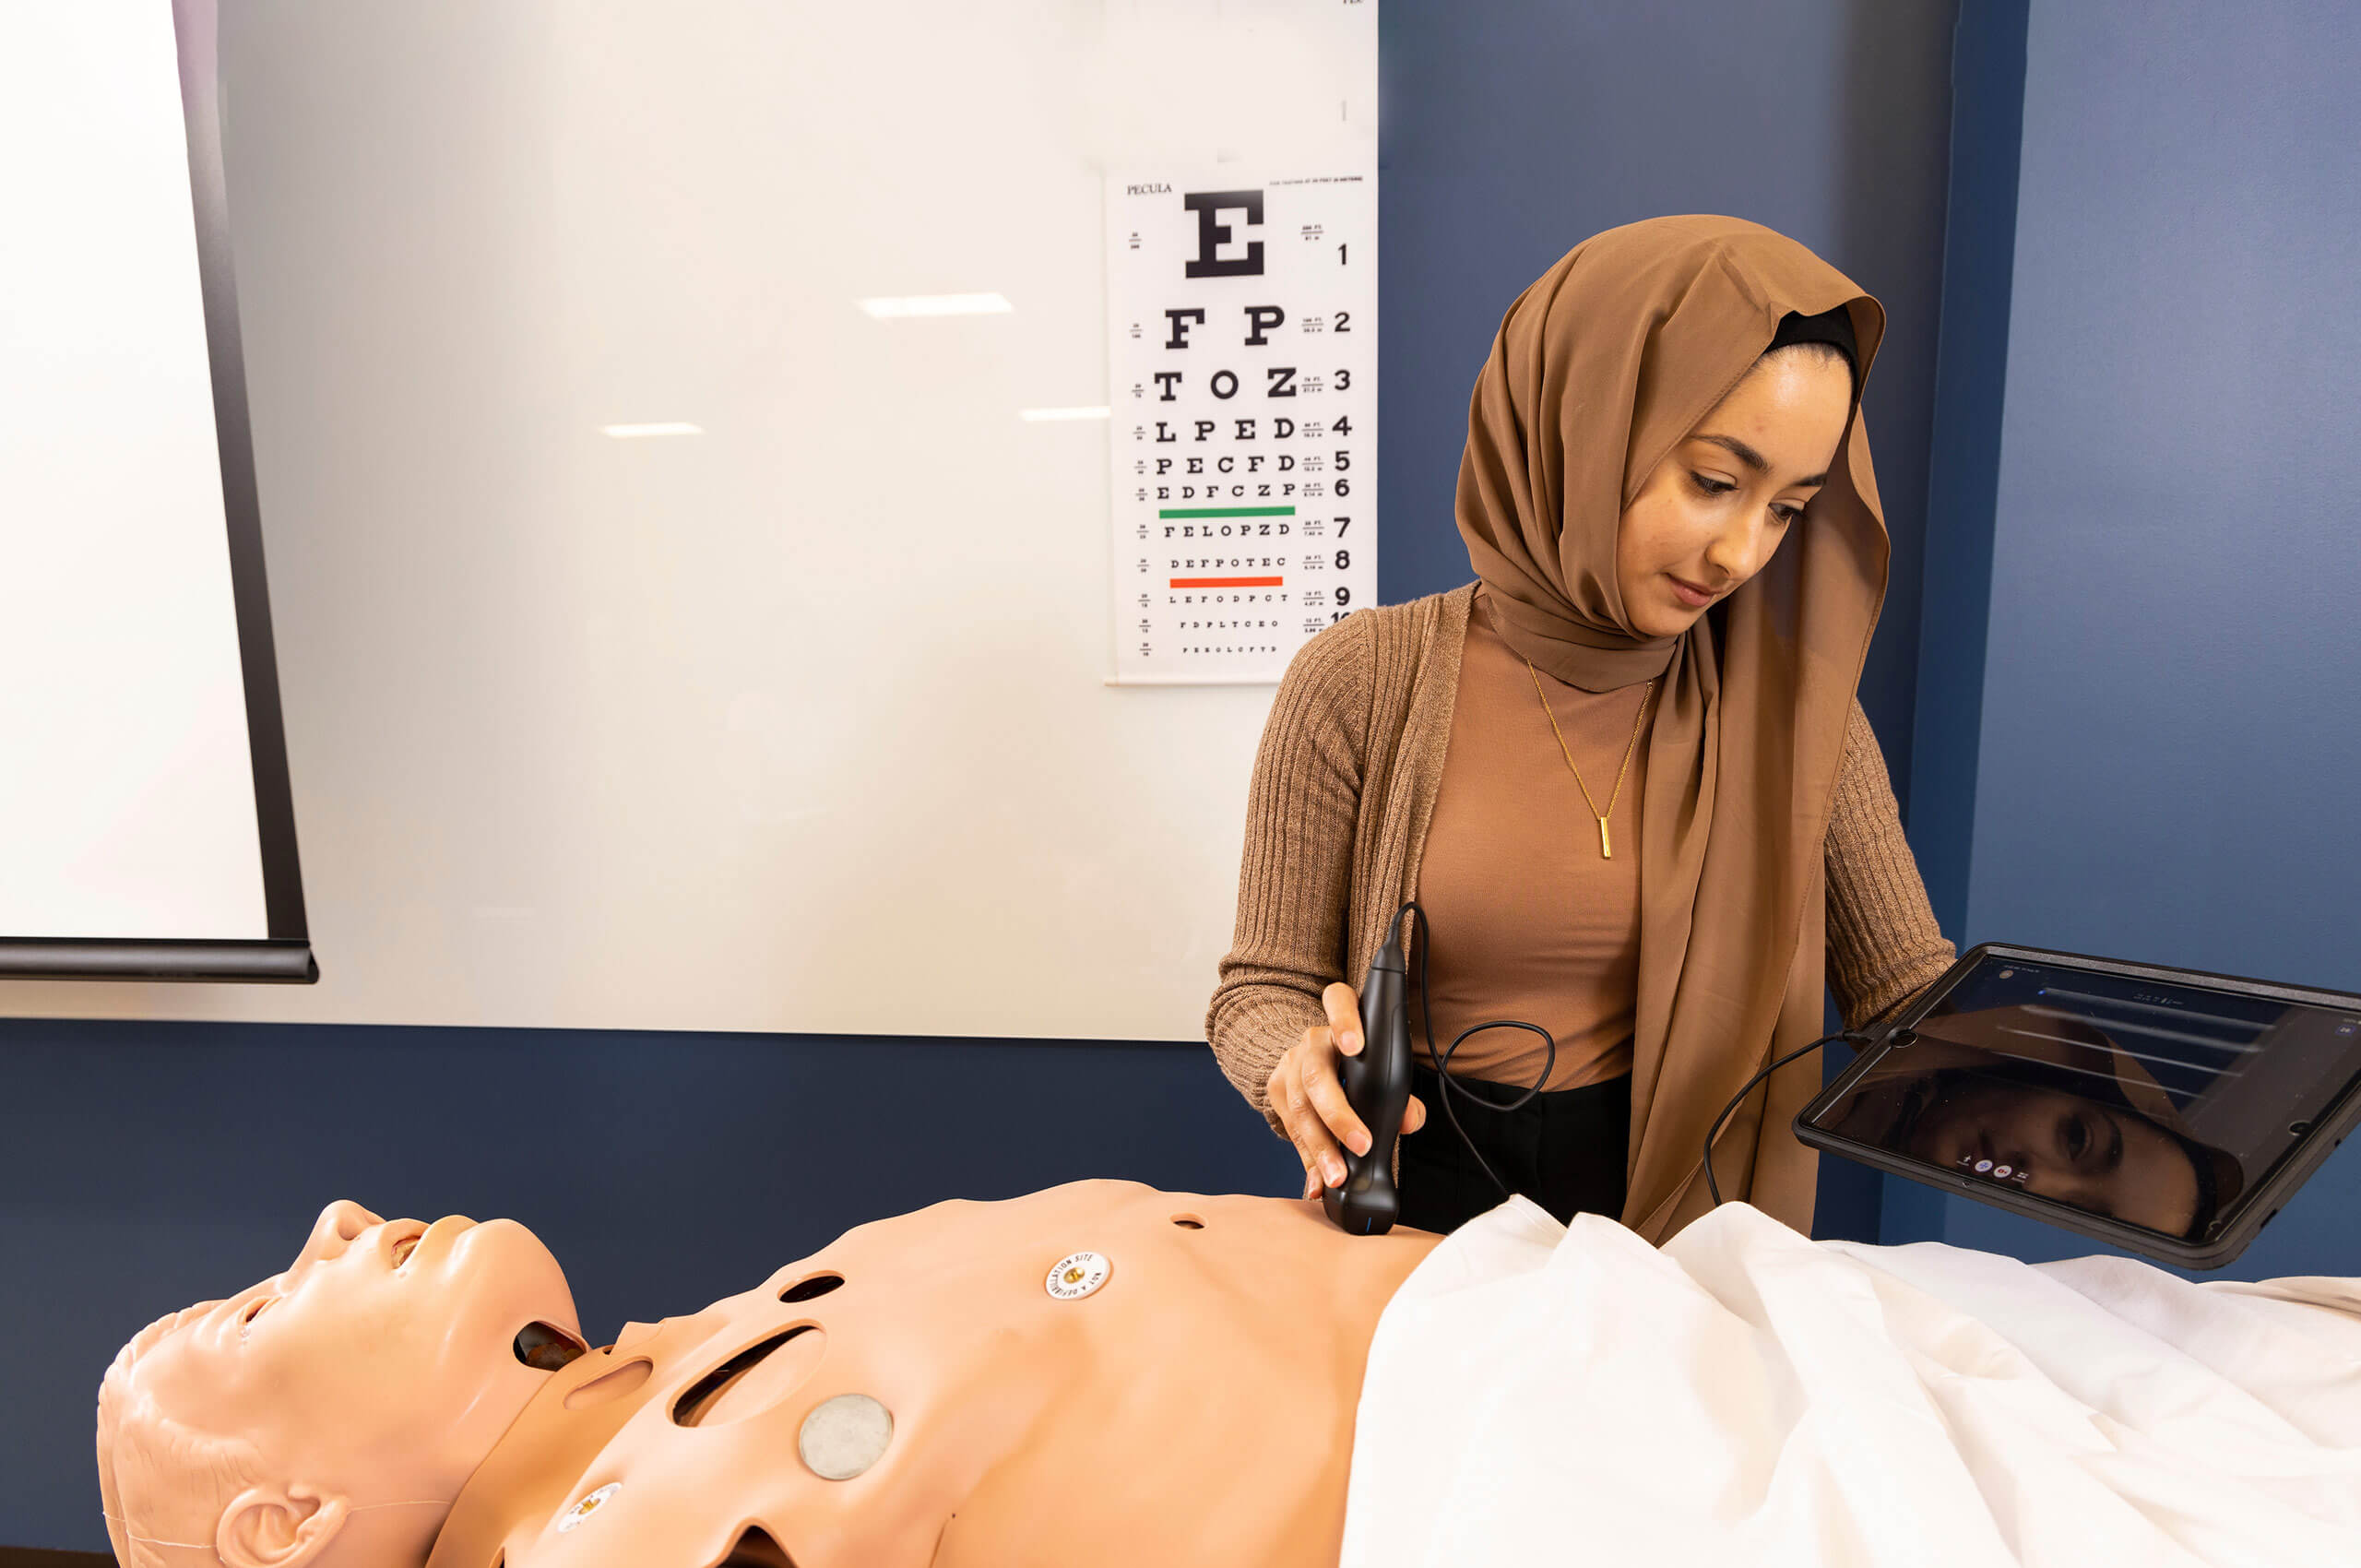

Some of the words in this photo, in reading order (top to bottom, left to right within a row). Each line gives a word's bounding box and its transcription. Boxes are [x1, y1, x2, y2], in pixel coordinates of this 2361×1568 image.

[1127, 184, 1172, 196] PECULA
[1184, 190, 1264, 279] E
[1338, 244, 1347, 266] 1
[1165, 308, 1205, 350] F
[1244, 305, 1285, 346] P
[1335, 312, 1351, 333] 2
[1154, 372, 1182, 401] T
[1210, 370, 1239, 399] O
[1267, 367, 1297, 398] Z
[1335, 369, 1351, 391] 3
[1332, 415, 1353, 437] 4
[1335, 450, 1351, 472] 5
[1335, 479, 1351, 498] 6
[1334, 517, 1351, 539] 7
[1335, 550, 1351, 570] 8
[1335, 587, 1351, 607] 9
